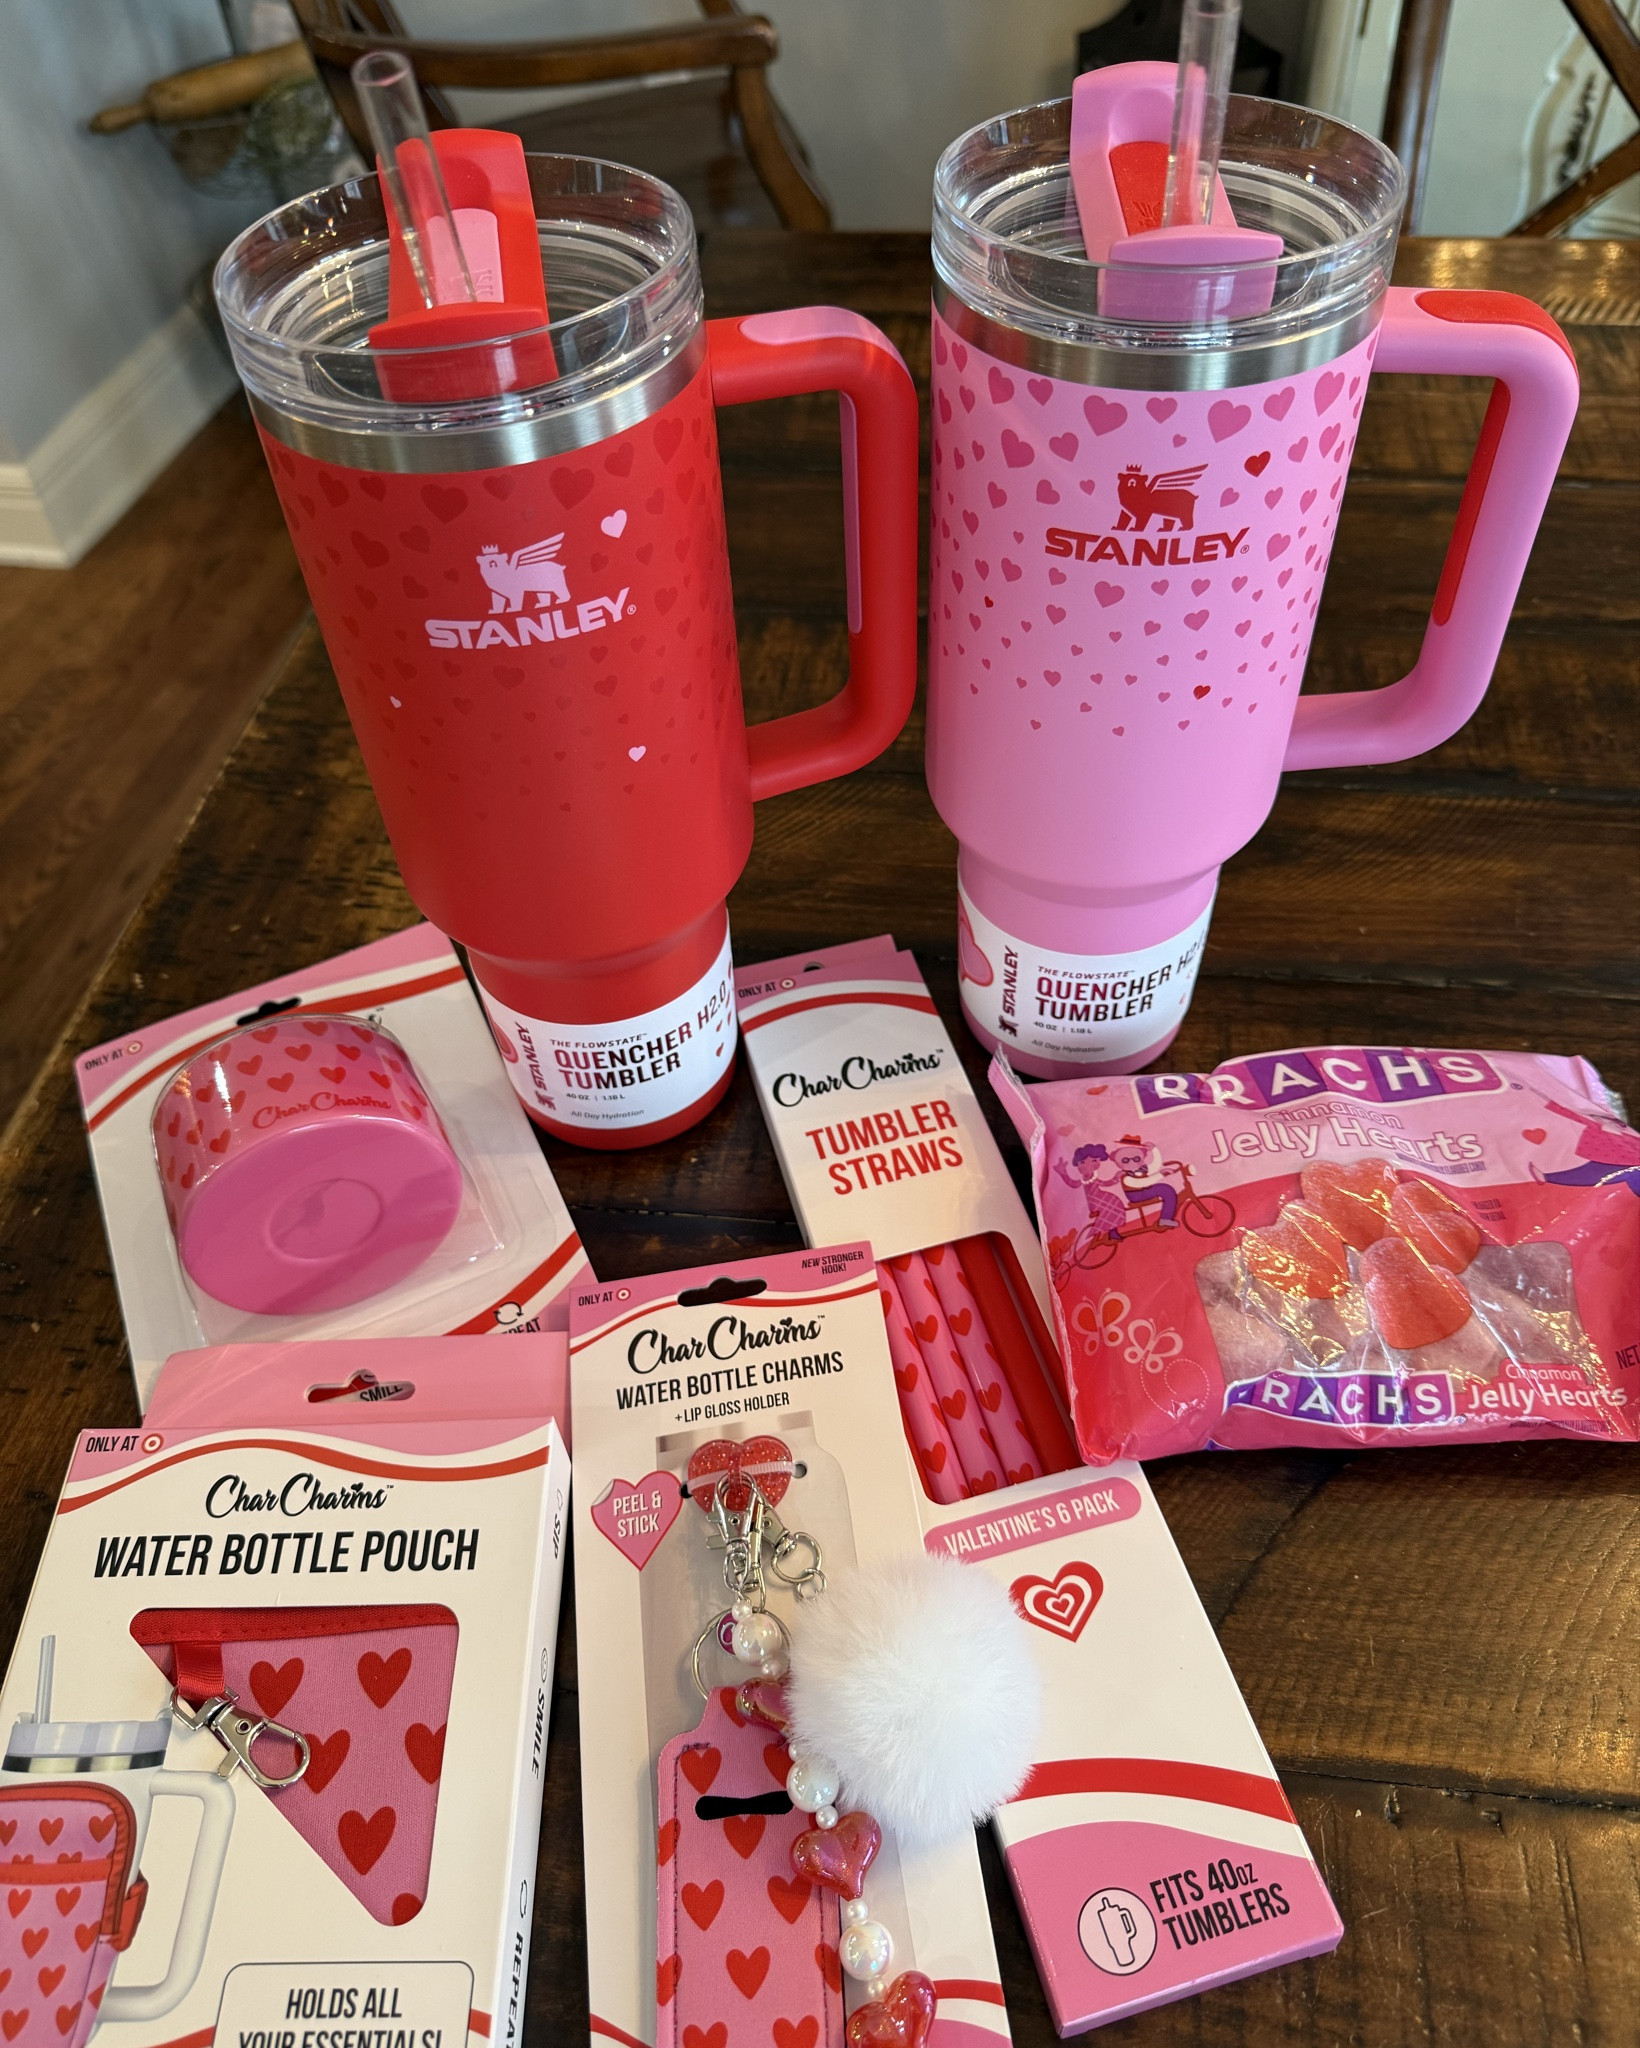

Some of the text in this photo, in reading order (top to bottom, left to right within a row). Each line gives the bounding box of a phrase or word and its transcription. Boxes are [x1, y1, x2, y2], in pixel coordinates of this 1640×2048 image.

[1044, 526, 1250, 567] STANLEY
[424, 587, 630, 650] STANLEY
[1003, 945, 1018, 1017] STANLEY
[1037, 964, 1172, 1001] QUENCHER
[1038, 966, 1129, 980] THE FLOWSTATE
[738, 982, 776, 999] ONLY AT
[1035, 993, 1153, 1022] TUMBLER
[554, 980, 726, 1070] QUENCHER H2.0
[515, 1021, 547, 1091] STANLEY
[550, 1034, 642, 1049] THE FLOWSTATE
[1045, 1042, 1060, 1051] Day
[85, 1049, 123, 1070] ONLY AT
[558, 1052, 681, 1090] TUMBLER
[584, 1112, 600, 1120] Day
[602, 1110, 644, 1120] Hydration
[805, 1100, 958, 1160] TUMBLER
[1264, 1101, 1405, 1130] Cinnamon
[1210, 1116, 1484, 1163] Jelly Hearts
[828, 1136, 963, 1196] STRAWS
[801, 1251, 864, 1270] NEW STRONGER
[822, 1262, 846, 1275] HOOK!
[578, 1291, 613, 1306] ONLY AT
[1505, 1364, 1582, 1381] Cinnamon
[1615, 1344, 1640, 1370] NET
[616, 1351, 844, 1411] WATER BOTTLE CHARMS
[704, 1400, 741, 1420] GLOSS
[744, 1392, 791, 1415] HOLDER
[1468, 1382, 1628, 1415] Jelly Hearts
[85, 1435, 139, 1453] ONLY AT
[613, 1489, 663, 1517] PEEL &
[552, 1513, 562, 1560] SIP
[617, 1516, 660, 1539] STICK
[944, 1489, 1120, 1555] VALENTINE'S 6 PACK
[93, 1528, 480, 1578] WATER BOTTLE POUCH
[531, 1687, 545, 1780] SMILE
[1149, 1869, 1204, 1913] FITS
[1162, 1883, 1290, 1950] TUMBLERS
[285, 1988, 403, 2019] HOLDS ALL
